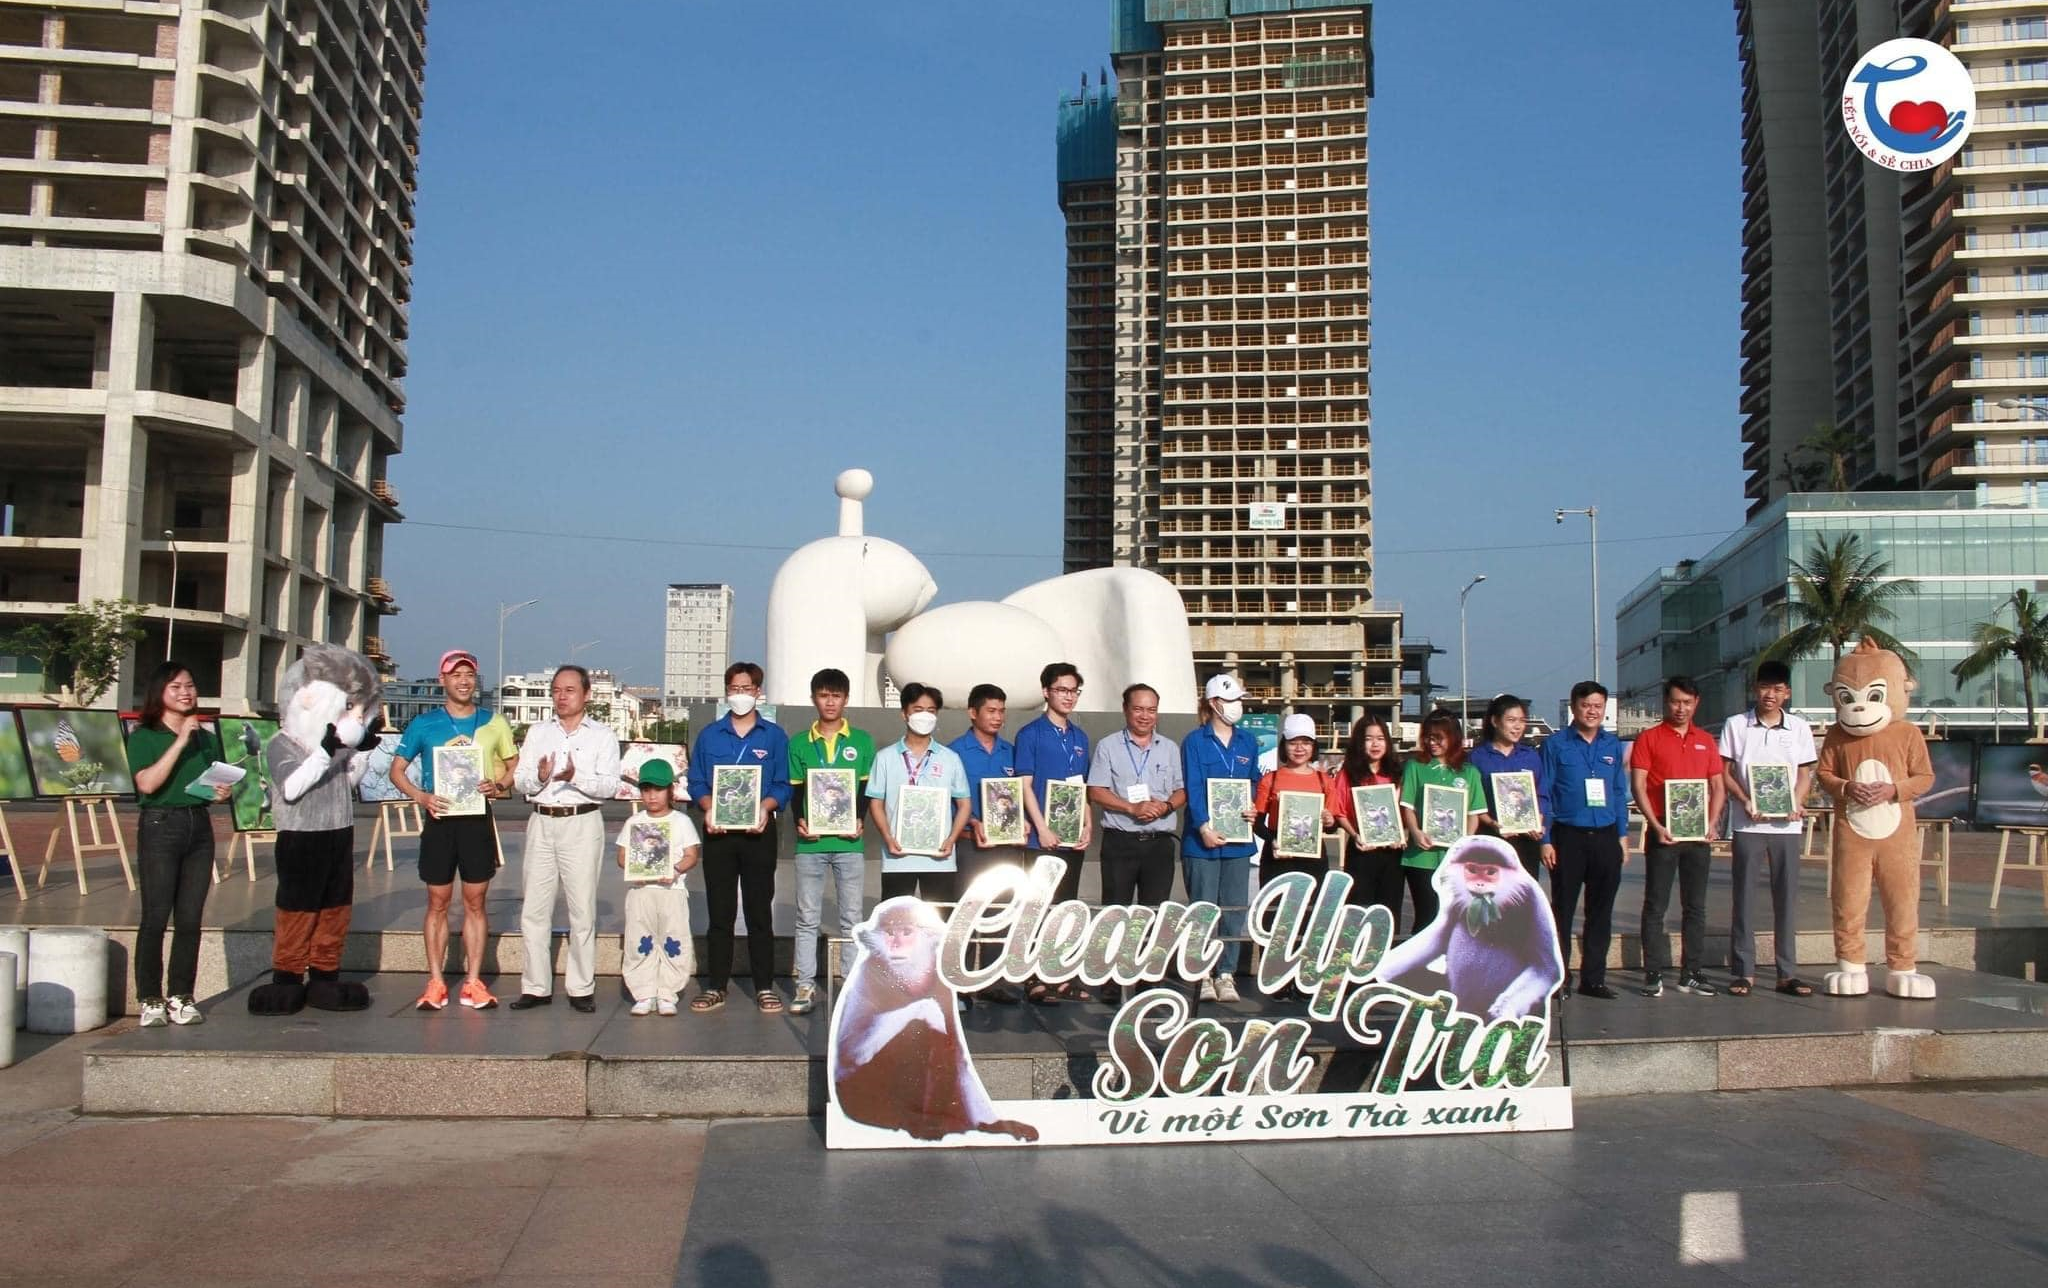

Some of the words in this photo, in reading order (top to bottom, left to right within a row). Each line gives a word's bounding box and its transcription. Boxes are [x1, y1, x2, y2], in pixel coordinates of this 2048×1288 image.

[936, 855, 1224, 993] Clean
[1248, 870, 1395, 1022] Up
[1092, 988, 1314, 1105] Son
[1343, 983, 1550, 1096] Tra
[1099, 1108, 1151, 1135] Vì
[1161, 1104, 1244, 1137] một
[1255, 1103, 1332, 1130] Sơn
[1345, 1102, 1412, 1128] Trà
[1421, 1097, 1521, 1126] xanh
